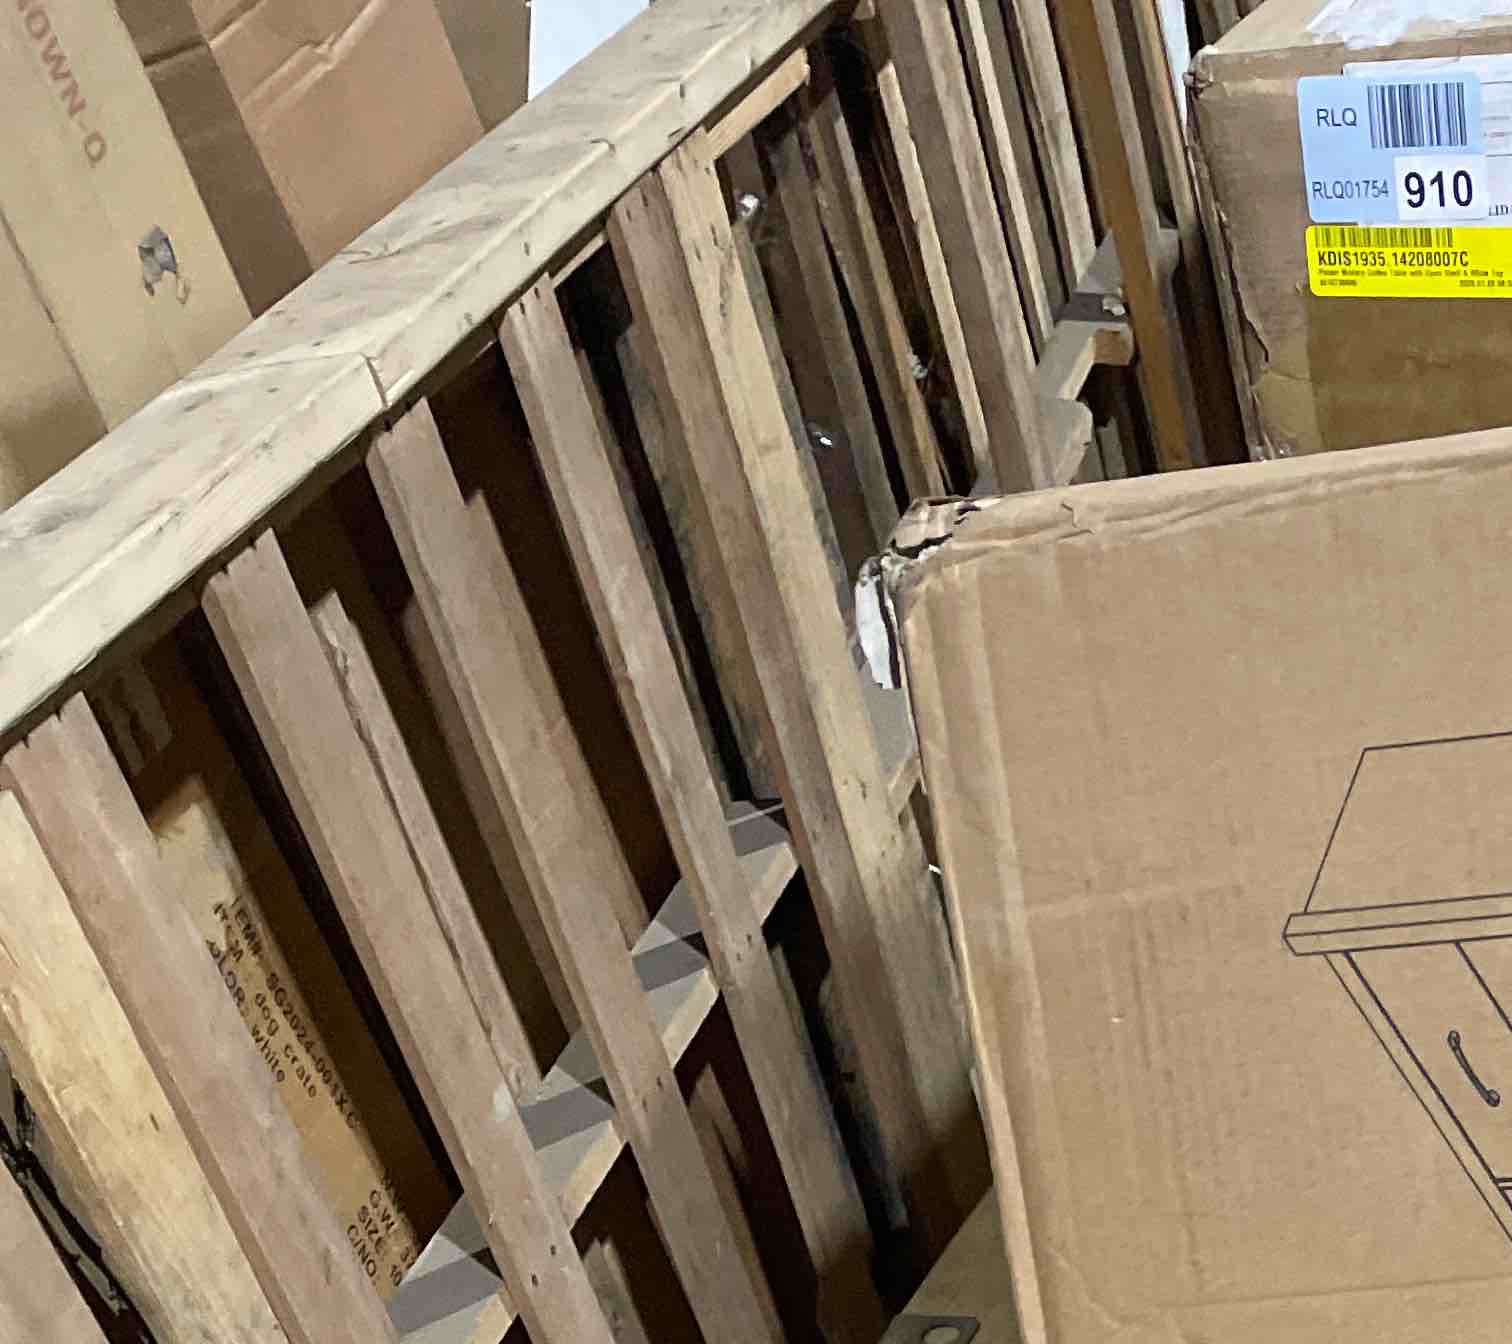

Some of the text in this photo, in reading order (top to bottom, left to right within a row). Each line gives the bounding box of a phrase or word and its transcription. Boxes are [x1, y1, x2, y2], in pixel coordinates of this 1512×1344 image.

[1316, 107, 1358, 127] RLQ
[1312, 179, 1389, 200] RLQ01754
[1404, 170, 1473, 208] 910
